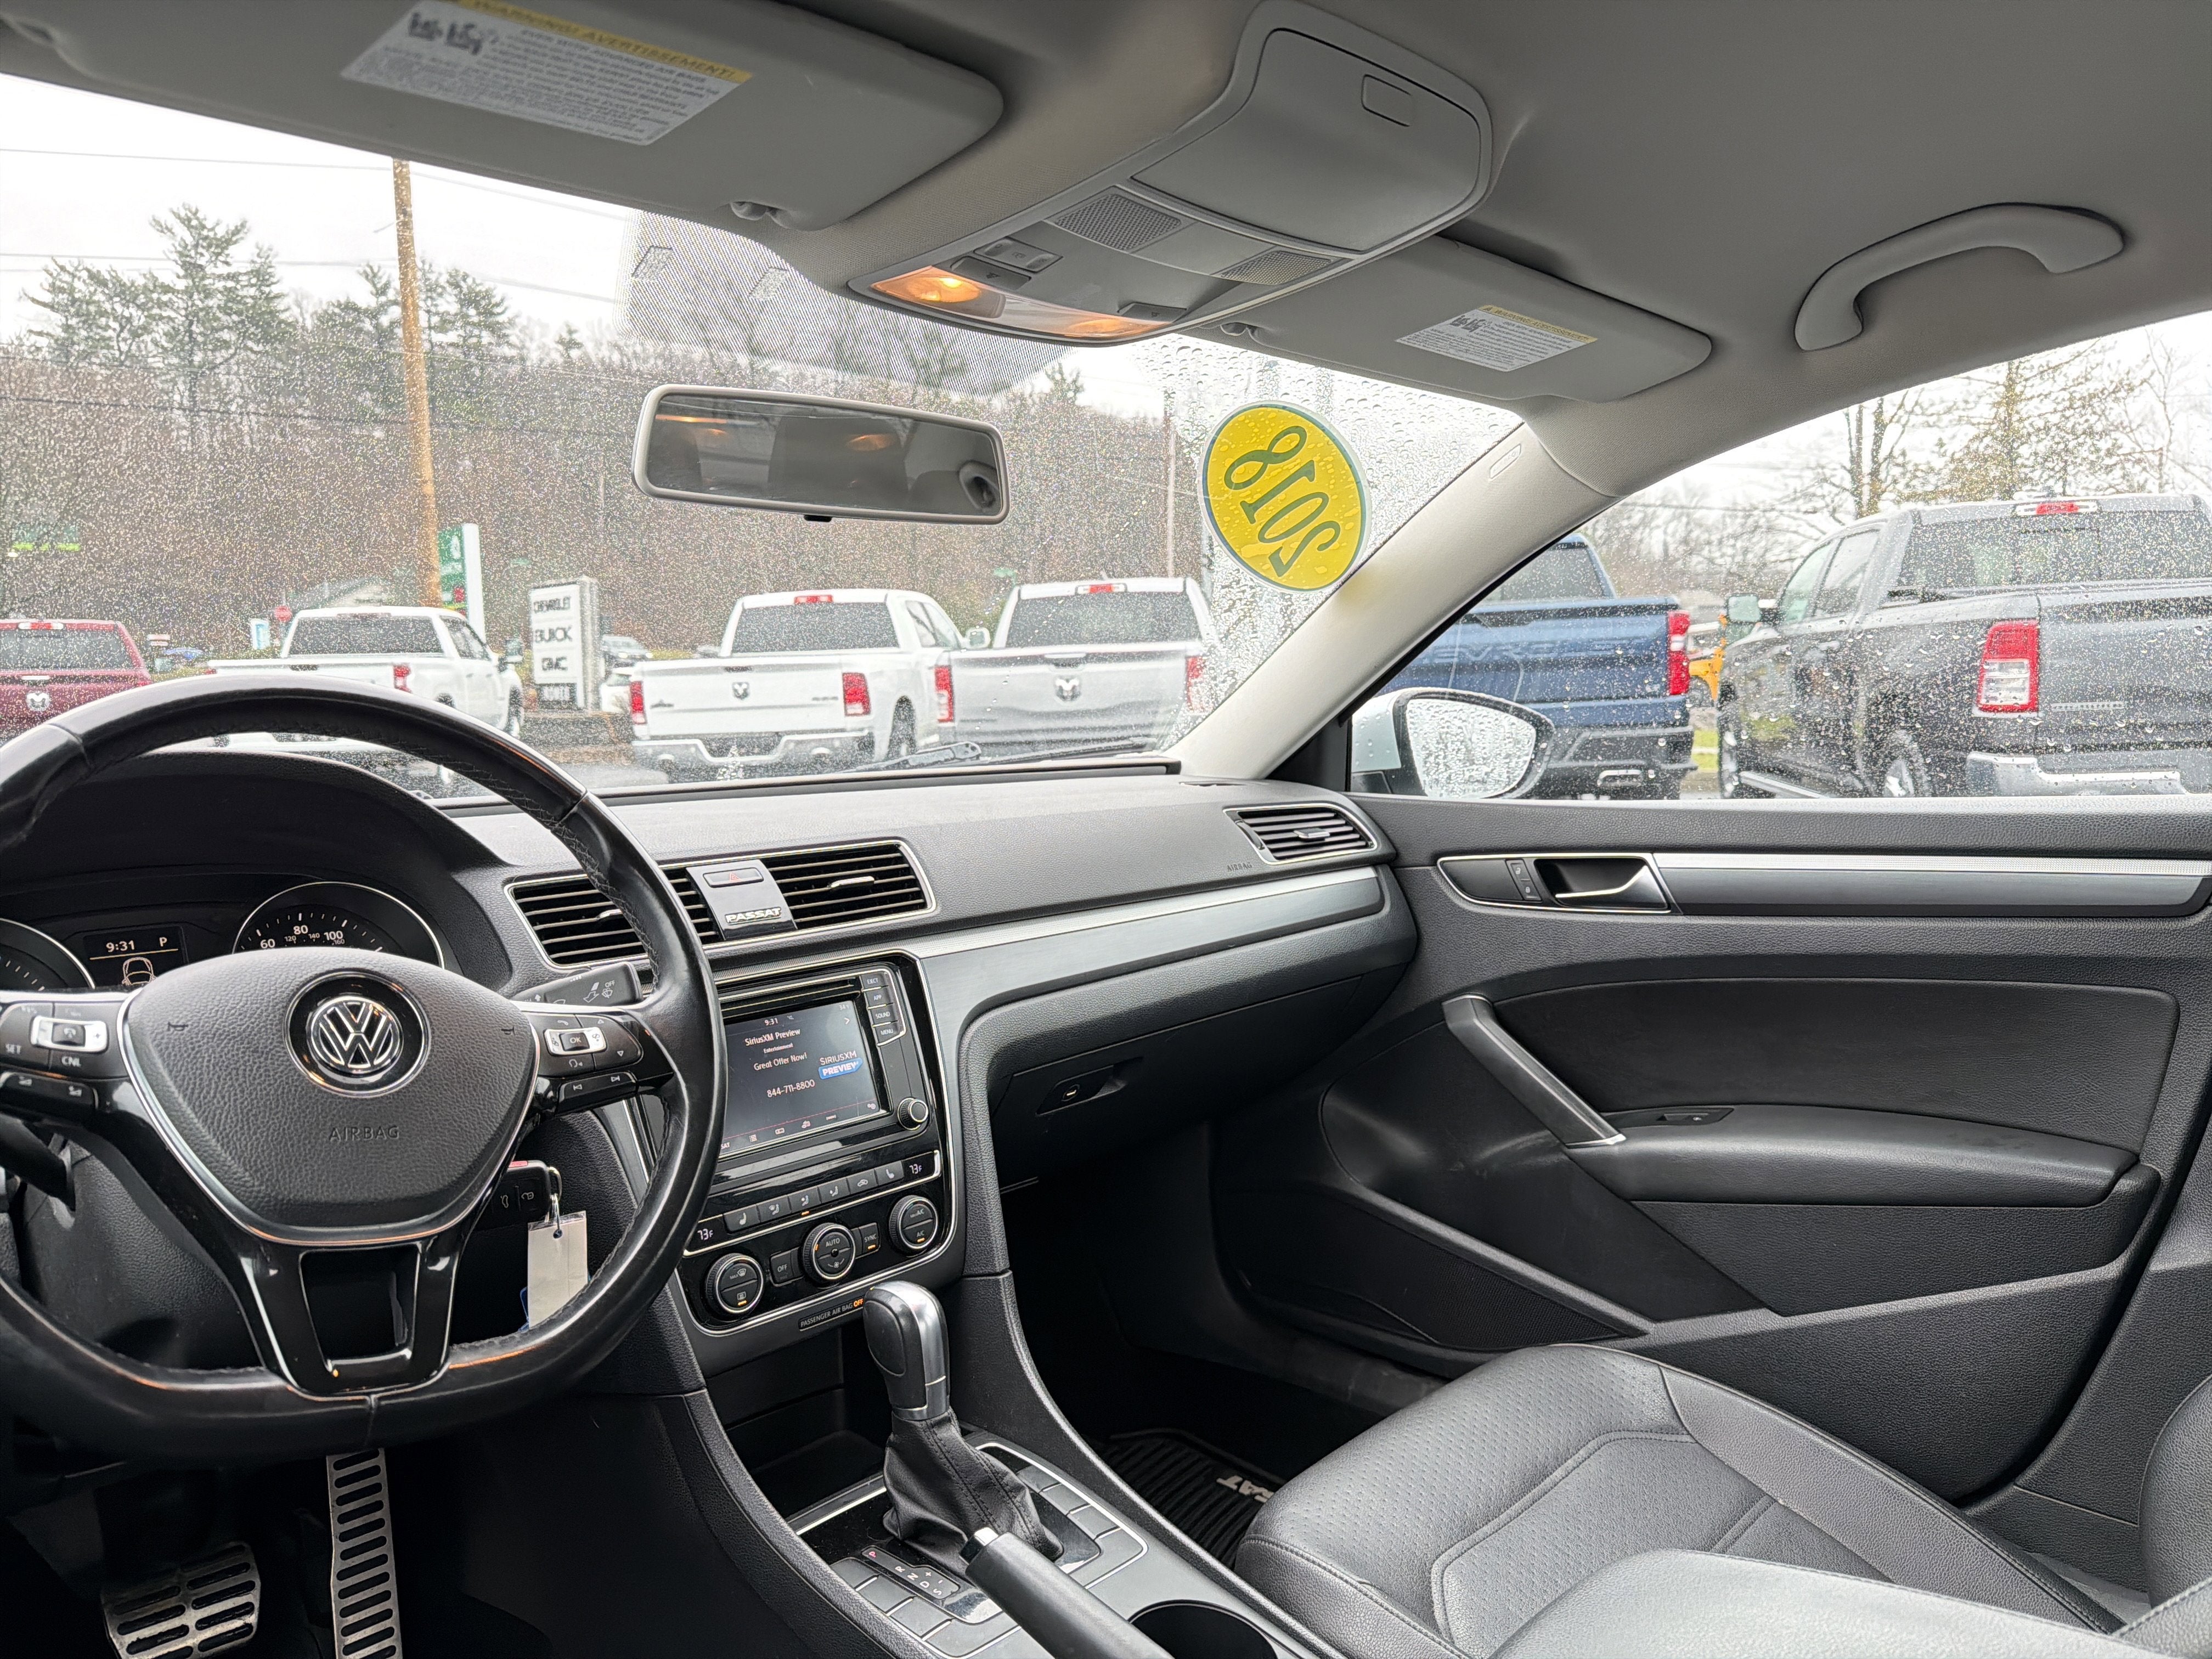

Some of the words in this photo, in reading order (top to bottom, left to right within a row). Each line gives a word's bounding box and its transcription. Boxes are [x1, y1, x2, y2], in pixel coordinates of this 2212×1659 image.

[534, 625, 573, 644] BUICK
[1227, 862, 1252, 872] AIRBAG
[726, 907, 781, 923] PASSAT
[293, 924, 308, 935] 80
[324, 930, 343, 941] 100
[106, 940, 134, 953] 9:31
[159, 936, 167, 947] P
[260, 939, 275, 949] 60
[875, 1011, 891, 1019] SOUND
[764, 1017, 779, 1026] 9:31
[744, 1032, 775, 1046] SiriusXM
[775, 1028, 801, 1040] Preview
[5, 1043, 22, 1055] SET
[61, 1056, 82, 1068] CNL
[753, 1059, 772, 1071] Great
[773, 1056, 789, 1067] Offer
[790, 1052, 808, 1063] Now!
[819, 1050, 857, 1066] SIRIUSXM
[766, 1079, 816, 1098] 844-711-8800
[329, 1125, 400, 1142] AIRBAG
[720, 1141, 730, 1150] SAT
[825, 1237, 841, 1248] AUTO
[864, 1233, 878, 1243] SYNC
[777, 1263, 788, 1273] OFF
[800, 1310, 832, 1328] PASSENGER
[831, 1307, 842, 1316] AIR
[842, 1302, 853, 1312] BAG
[853, 1298, 865, 1308] OFF
